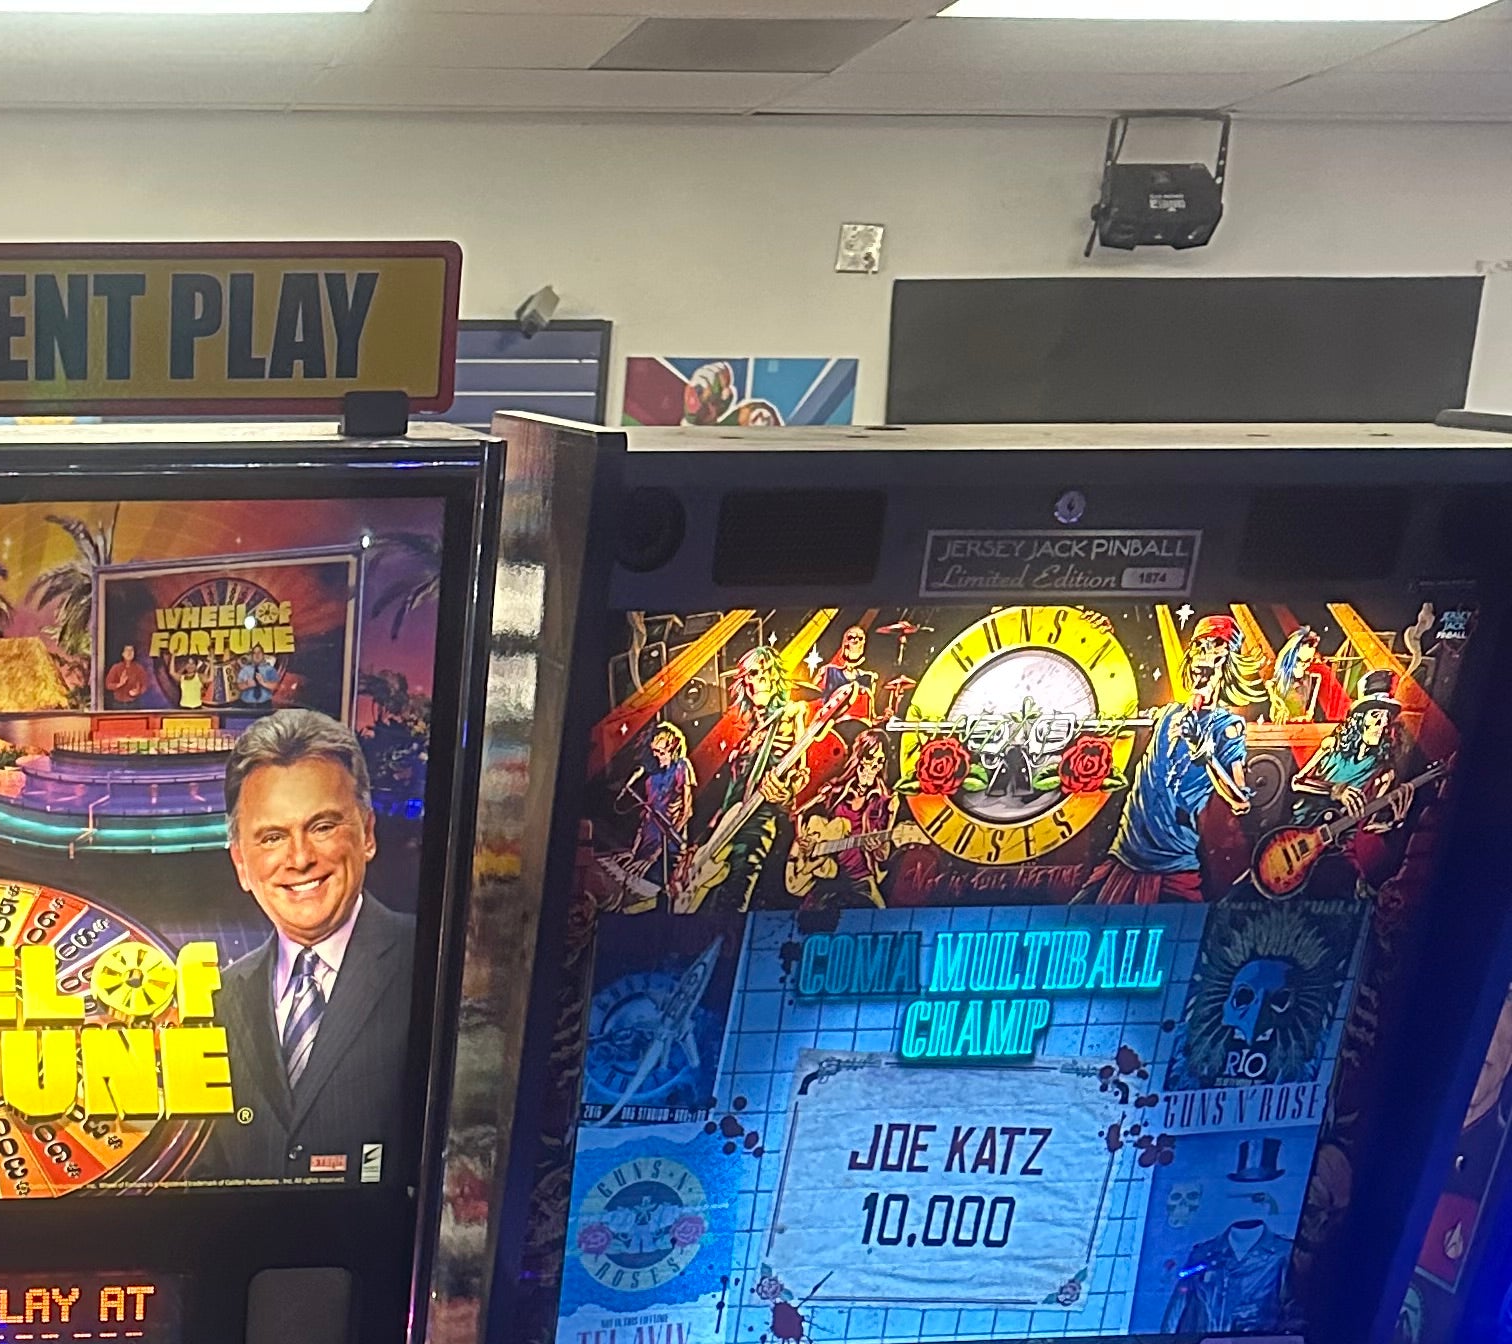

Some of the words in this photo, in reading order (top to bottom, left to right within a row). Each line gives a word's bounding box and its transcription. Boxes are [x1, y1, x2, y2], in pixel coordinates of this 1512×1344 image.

[169, 271, 380, 381] PLAY
[938, 540, 1025, 561] JERSEY
[1025, 539, 1088, 561] JACK
[1090, 538, 1189, 560] PINBALL
[932, 564, 1031, 589] Limited
[1032, 564, 1117, 590] Edition
[155, 602, 250, 630] WHEEL
[149, 626, 295, 657] FORTUNE
[951, 608, 1068, 673] GUNS
[927, 807, 1073, 862] ROSES
[799, 931, 921, 995] COMA
[929, 927, 1166, 993] MULTIBALL
[901, 999, 1051, 1059] CHAMP
[1223, 1048, 1267, 1078] RIO
[1163, 1091, 1227, 1129] GUNS
[848, 1123, 937, 1173] JOE
[944, 1126, 1053, 1176] KATZ
[594, 1257, 681, 1289] ROSES
[99, 1285, 155, 1322] AT
